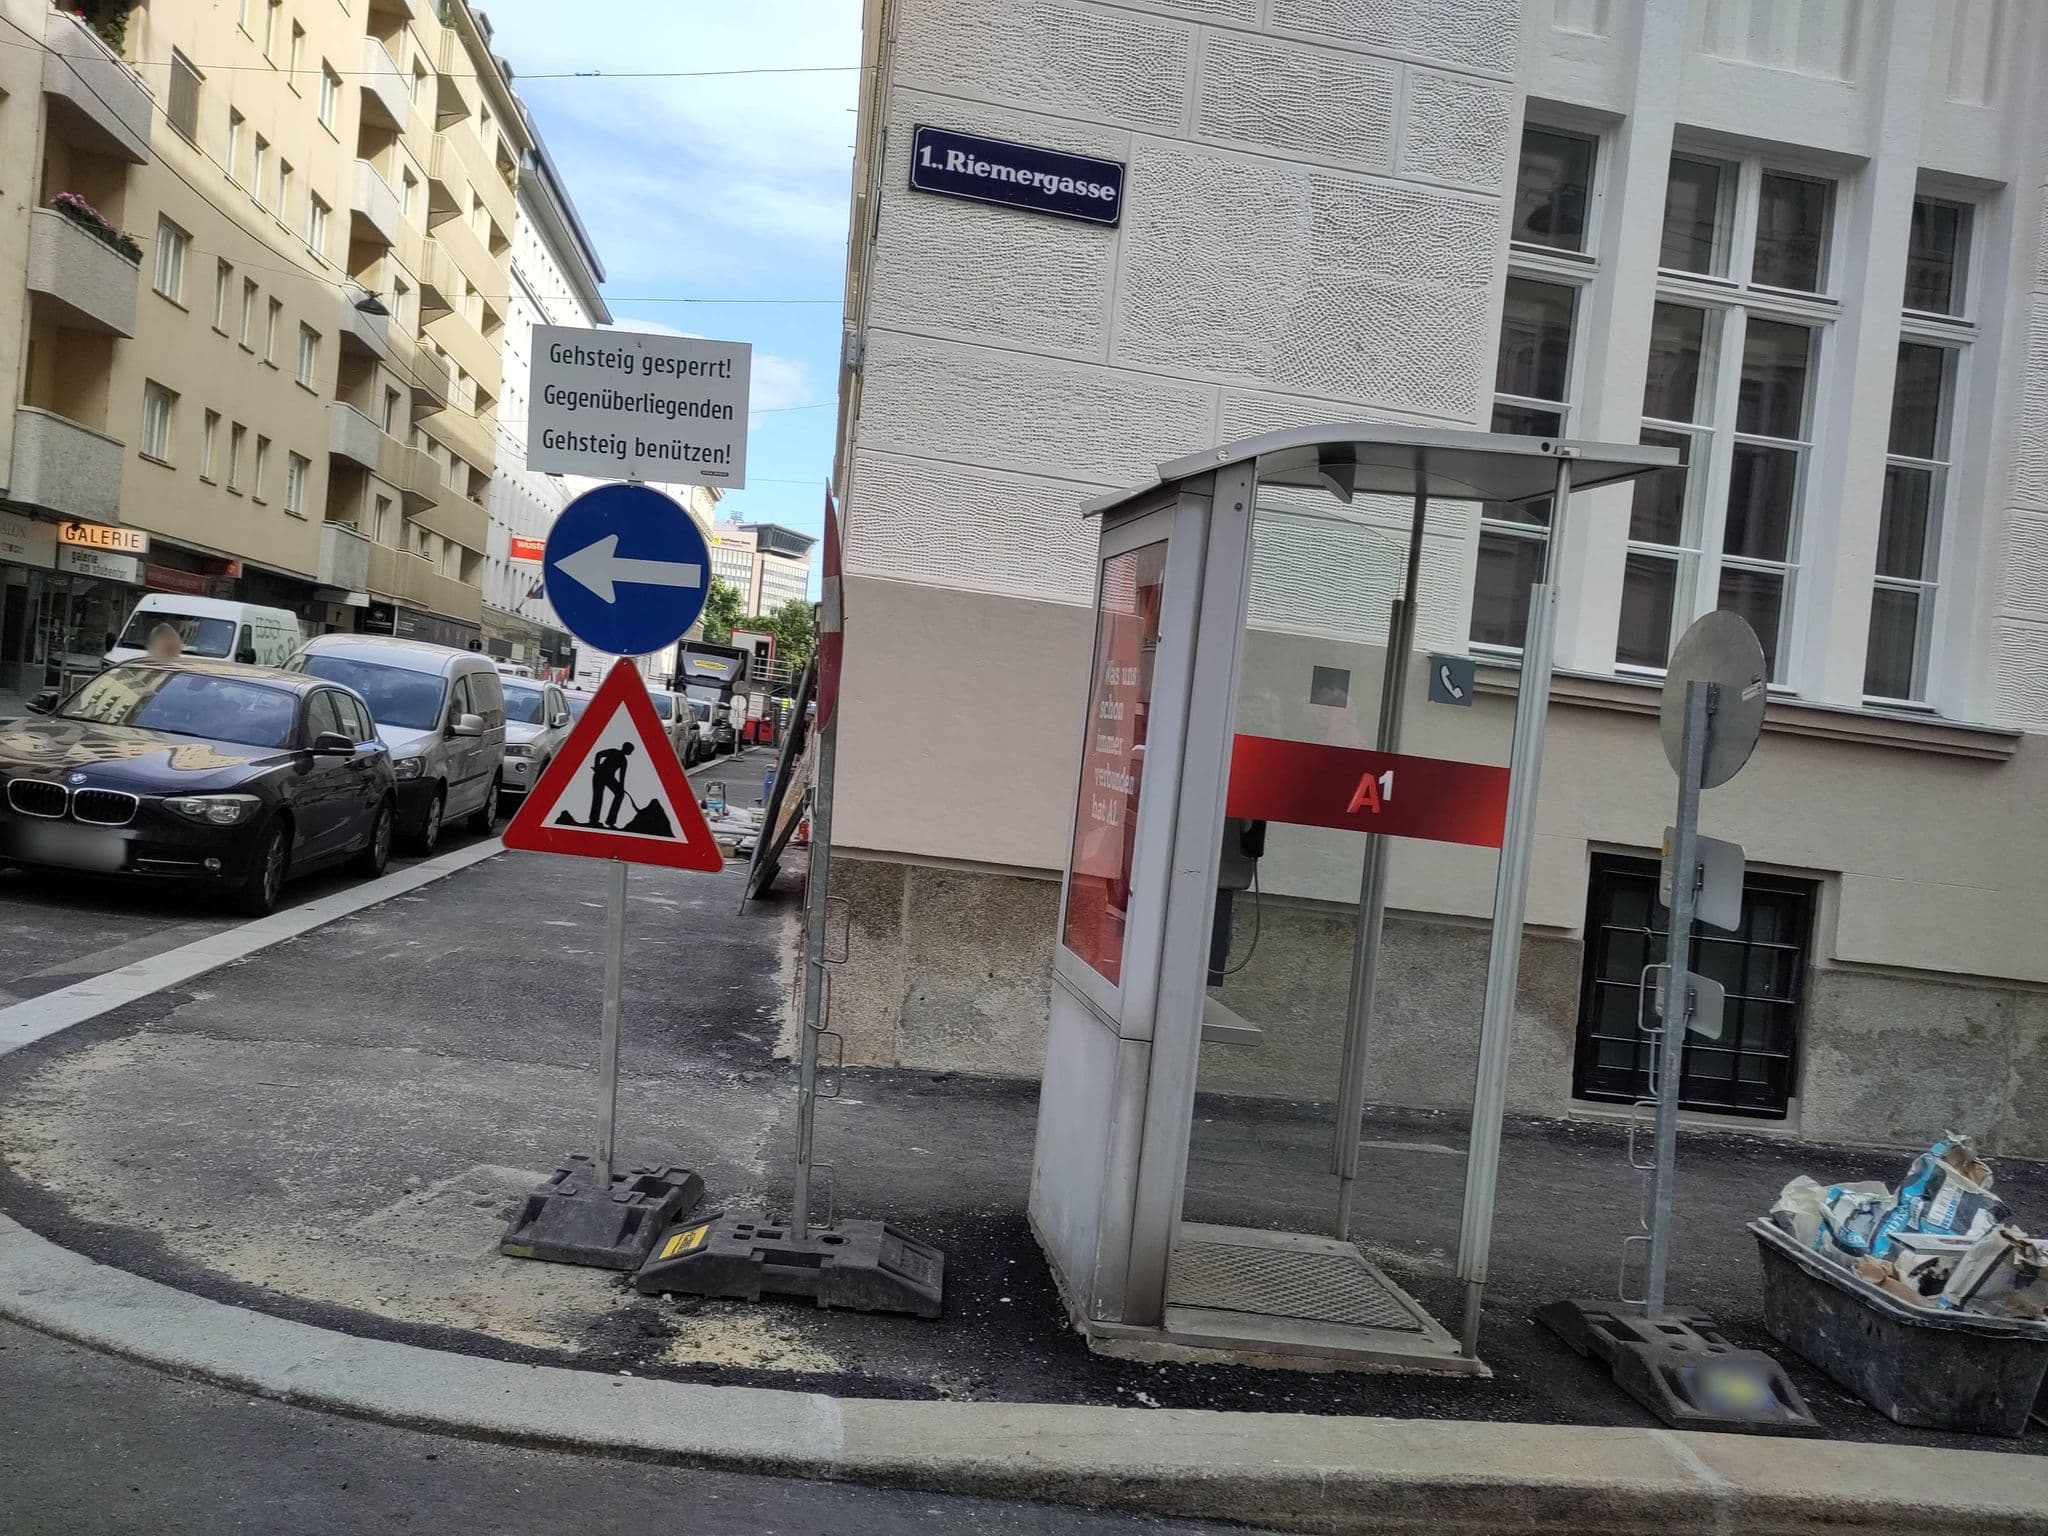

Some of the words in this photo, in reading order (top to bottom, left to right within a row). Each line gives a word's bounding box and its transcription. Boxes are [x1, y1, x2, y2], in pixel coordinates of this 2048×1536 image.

[946, 149, 1117, 201] Riemergasse
[549, 342, 635, 375] Gehsteig
[641, 356, 732, 380] gesperrt!
[543, 383, 734, 421] Gegenüberliegenden
[542, 428, 627, 460] Gehsteig
[634, 436, 731, 465] benützen!
[65, 525, 141, 549] GALERIE
[71, 550, 98, 564] galerie
[1099, 693, 1124, 721] schon
[1095, 727, 1124, 756] immer
[1094, 762, 1136, 795] verbunden
[1346, 769, 1395, 814] A1
